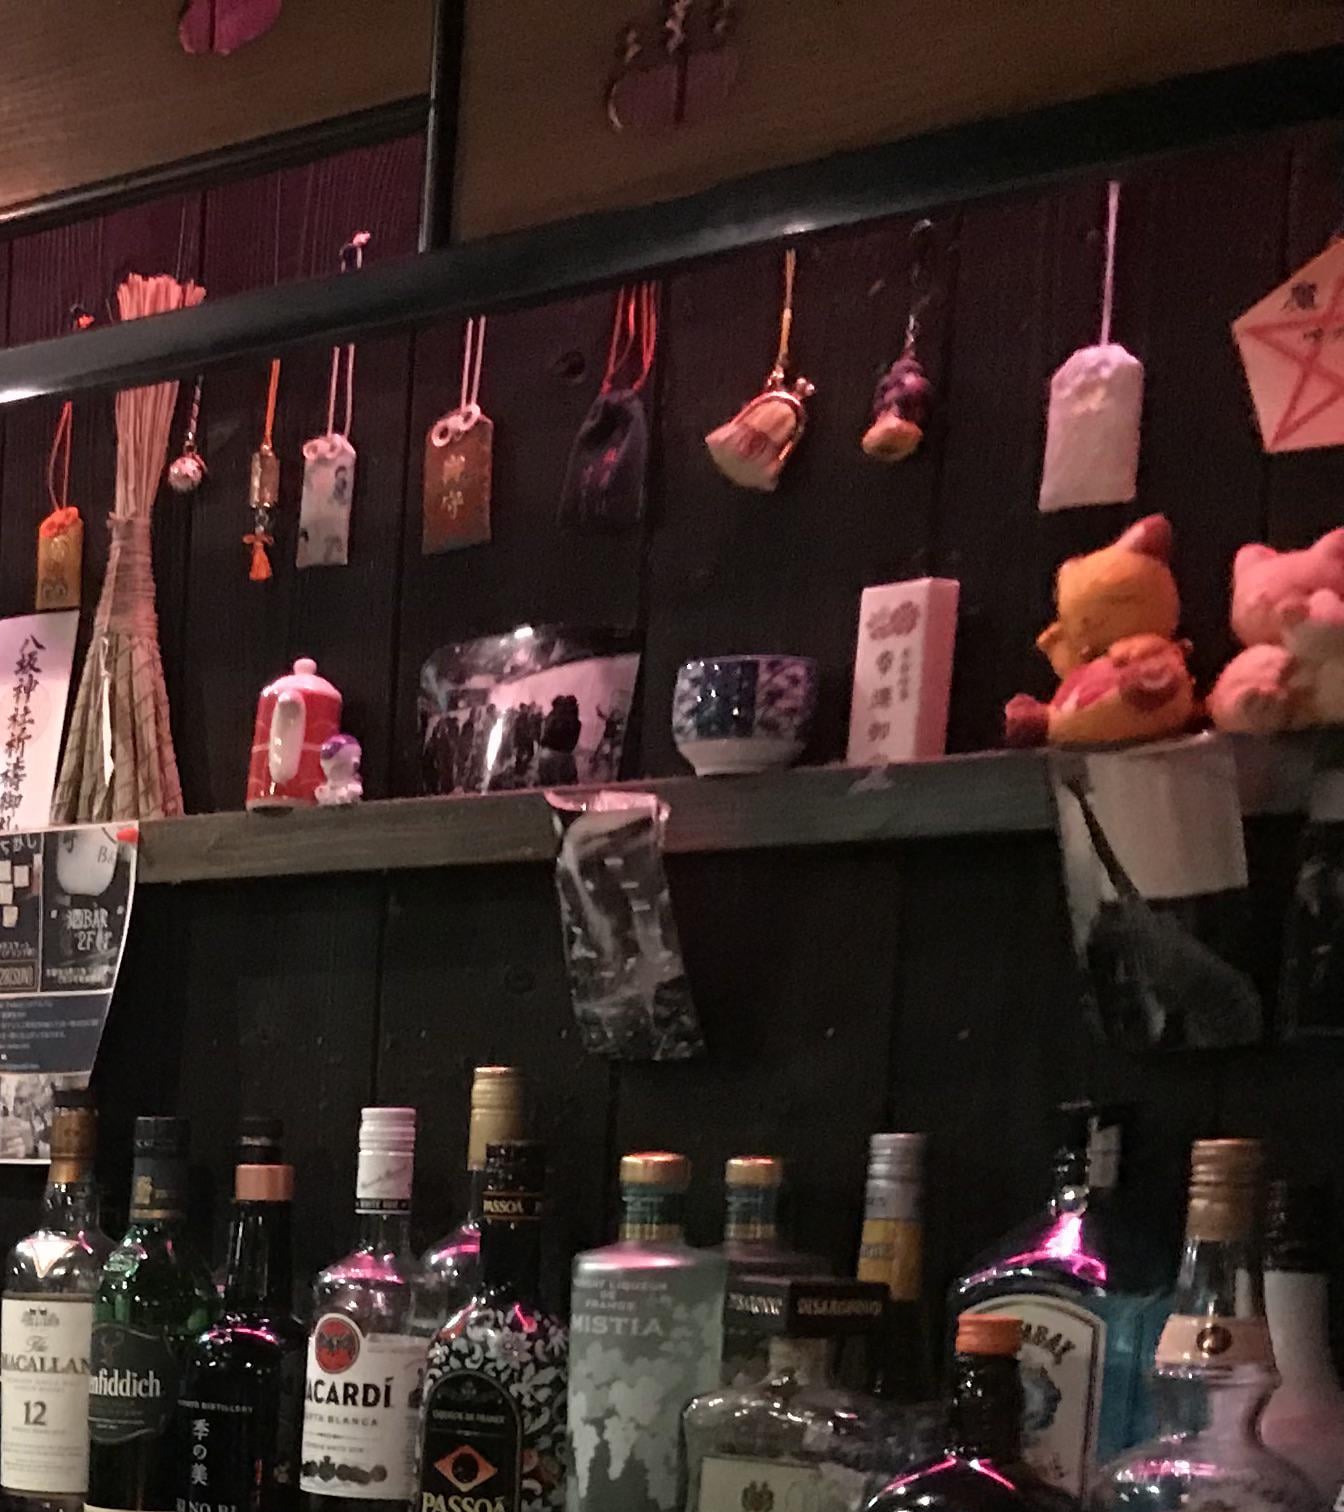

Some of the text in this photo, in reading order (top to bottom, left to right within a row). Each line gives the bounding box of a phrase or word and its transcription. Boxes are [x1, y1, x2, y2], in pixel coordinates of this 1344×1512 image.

[89, 1368, 161, 1398] nfiddich
[306, 1377, 395, 1408] ACARDÍ
[23, 1400, 47, 1426] 12
[192, 1418, 210, 1486] 季の美
